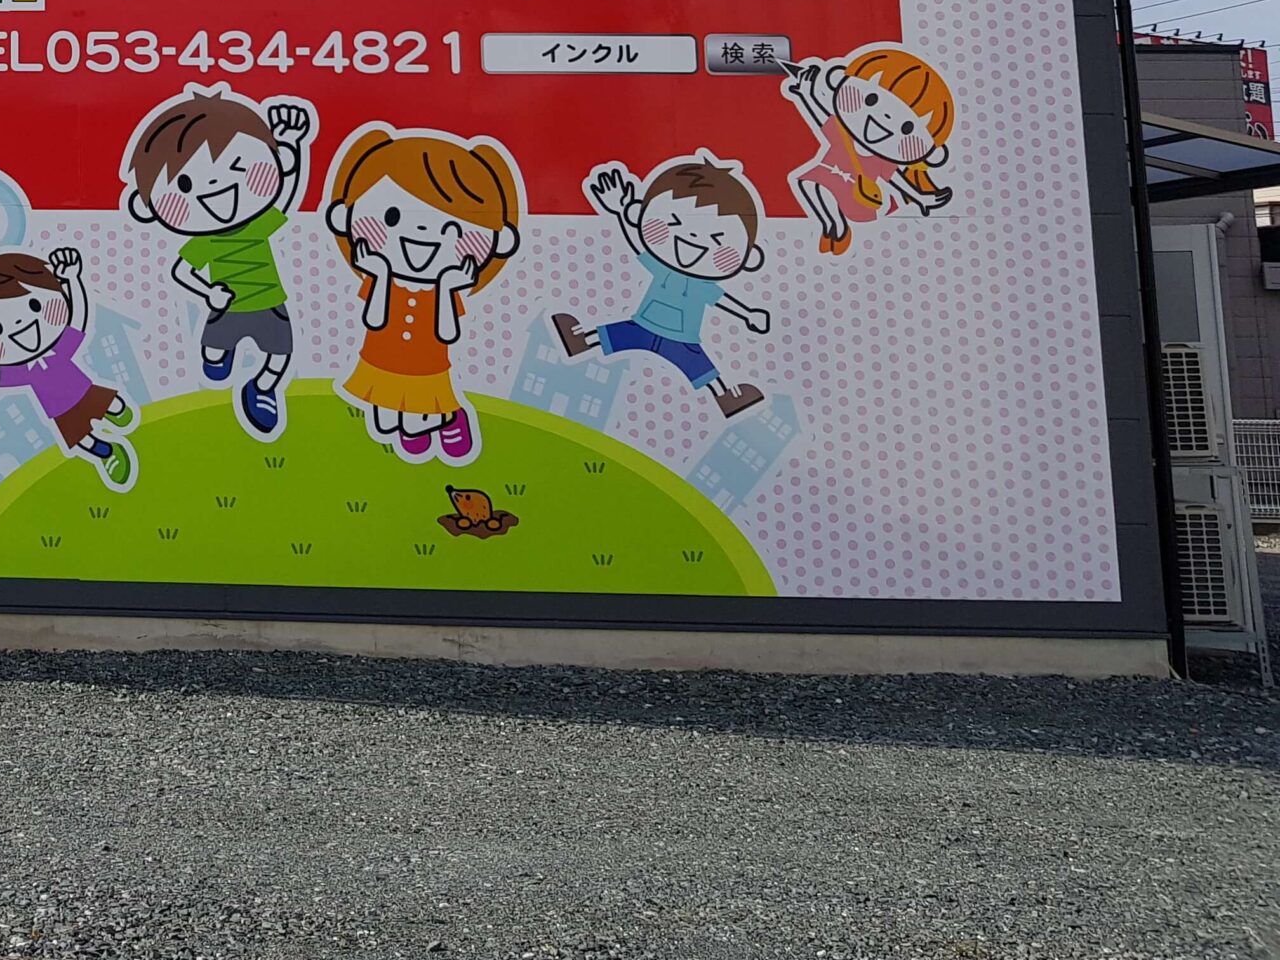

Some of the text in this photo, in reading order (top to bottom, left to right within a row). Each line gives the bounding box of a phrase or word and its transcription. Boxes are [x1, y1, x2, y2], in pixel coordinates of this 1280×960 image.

[541, 42, 640, 64] インクル
[721, 42, 776, 65] 検索
